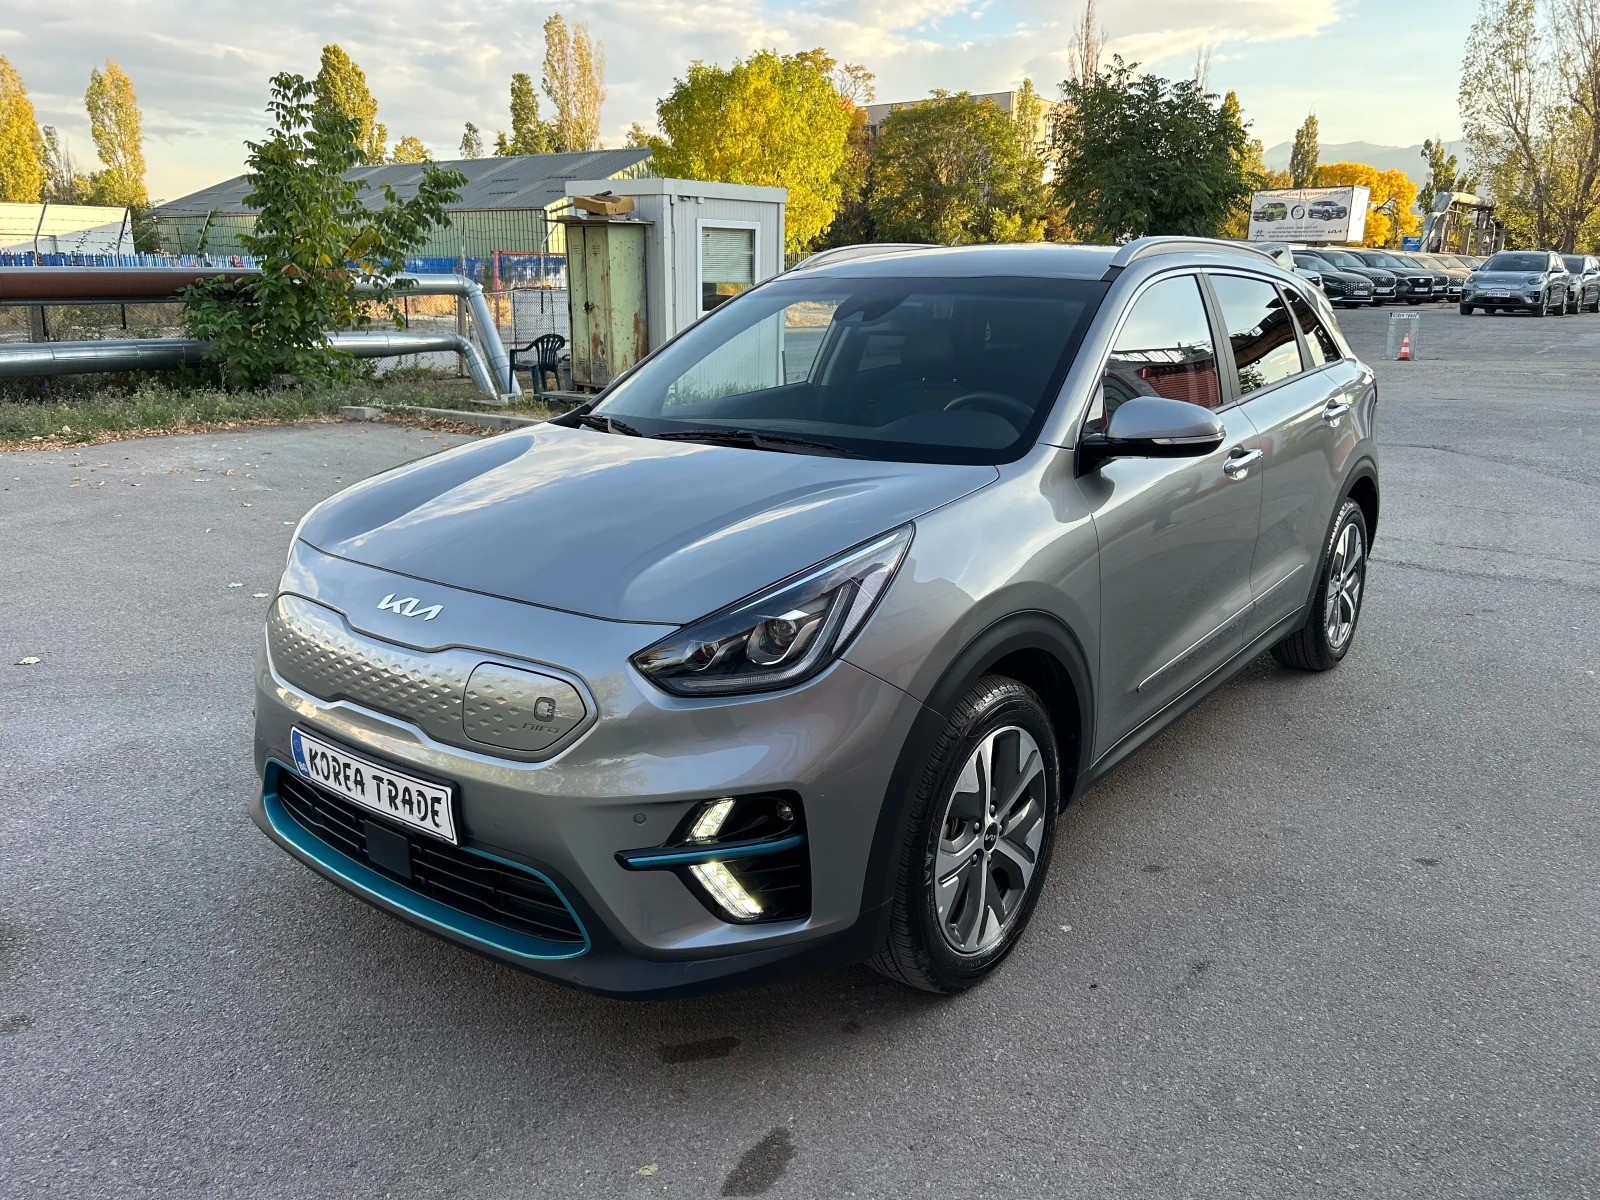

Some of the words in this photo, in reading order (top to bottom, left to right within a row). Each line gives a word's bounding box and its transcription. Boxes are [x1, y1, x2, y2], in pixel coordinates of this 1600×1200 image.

[377, 593, 444, 621] KIA
[309, 746, 365, 797] KOREA
[371, 774, 442, 829] TRADE
